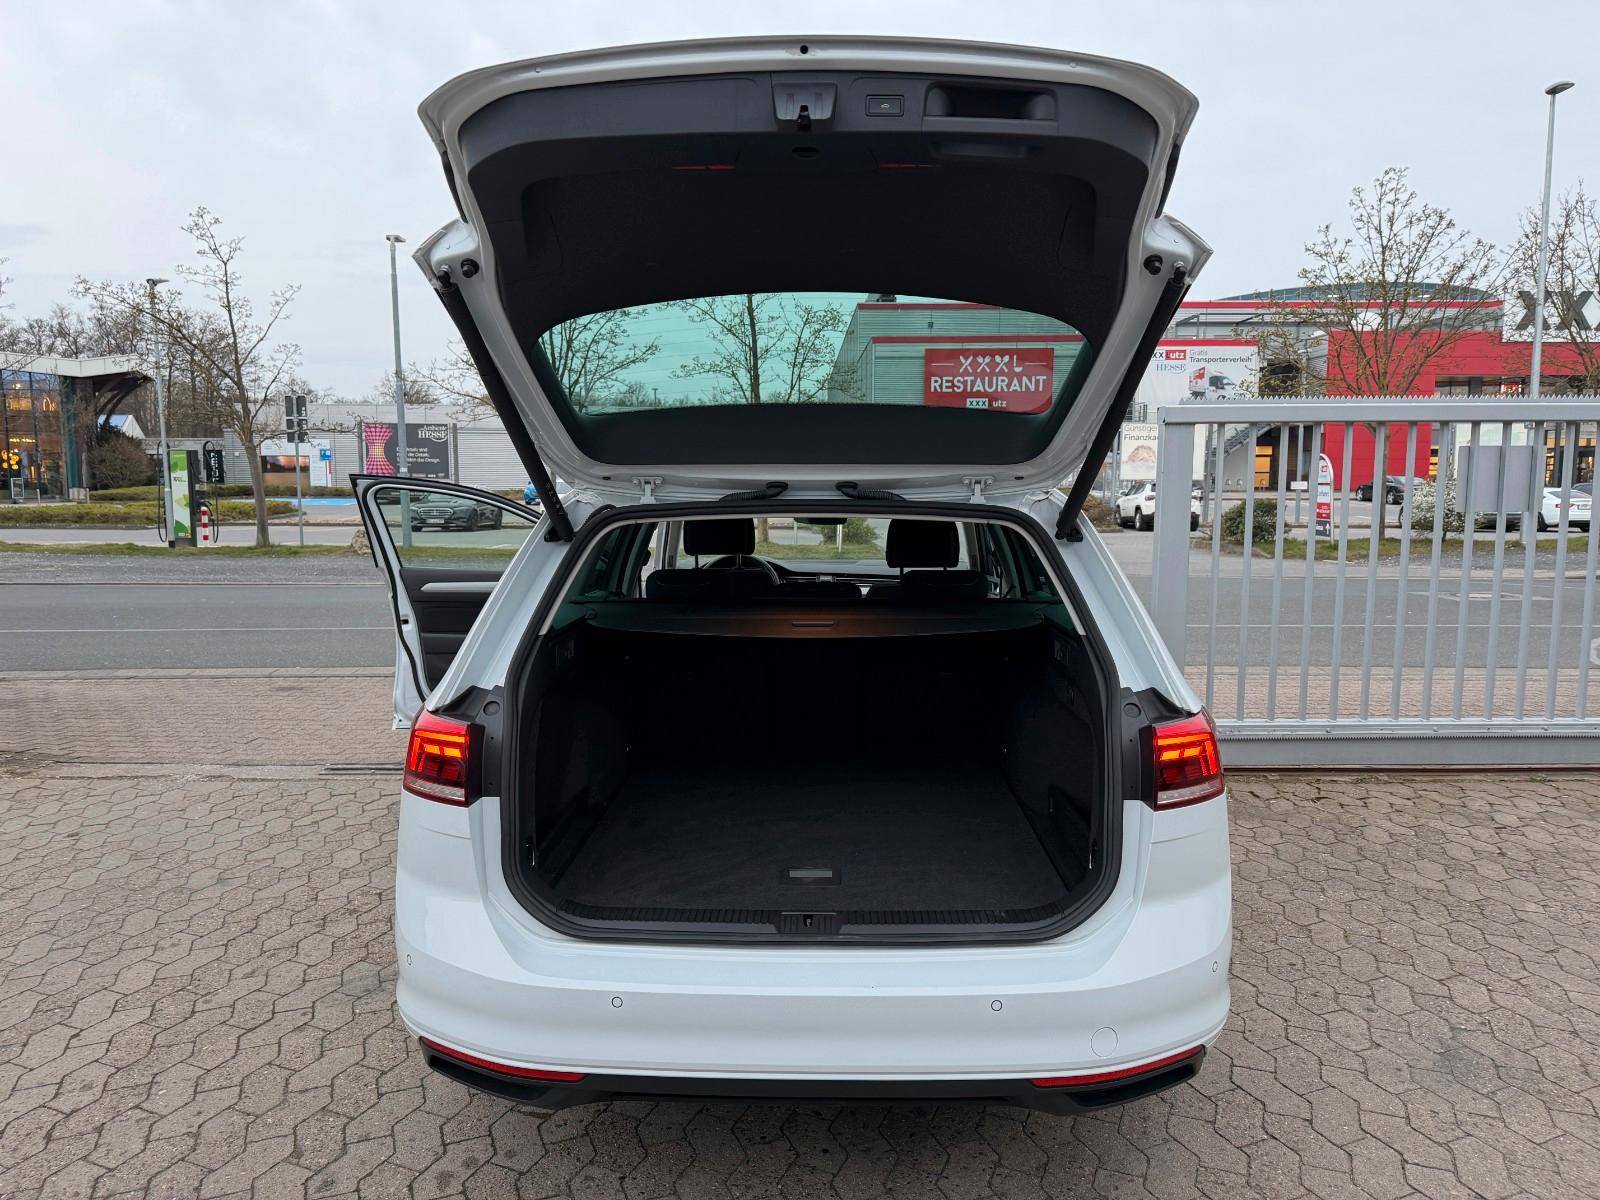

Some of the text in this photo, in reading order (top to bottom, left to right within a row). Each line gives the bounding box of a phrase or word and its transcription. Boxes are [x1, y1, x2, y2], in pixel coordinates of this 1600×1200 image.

[1189, 356, 1252, 364] Transporterverleih
[1156, 363, 1185, 372] HESSE
[930, 375, 1047, 393] RESTAURANT
[418, 430, 448, 439] HESSE
[1123, 433, 1158, 441] Finanzka
